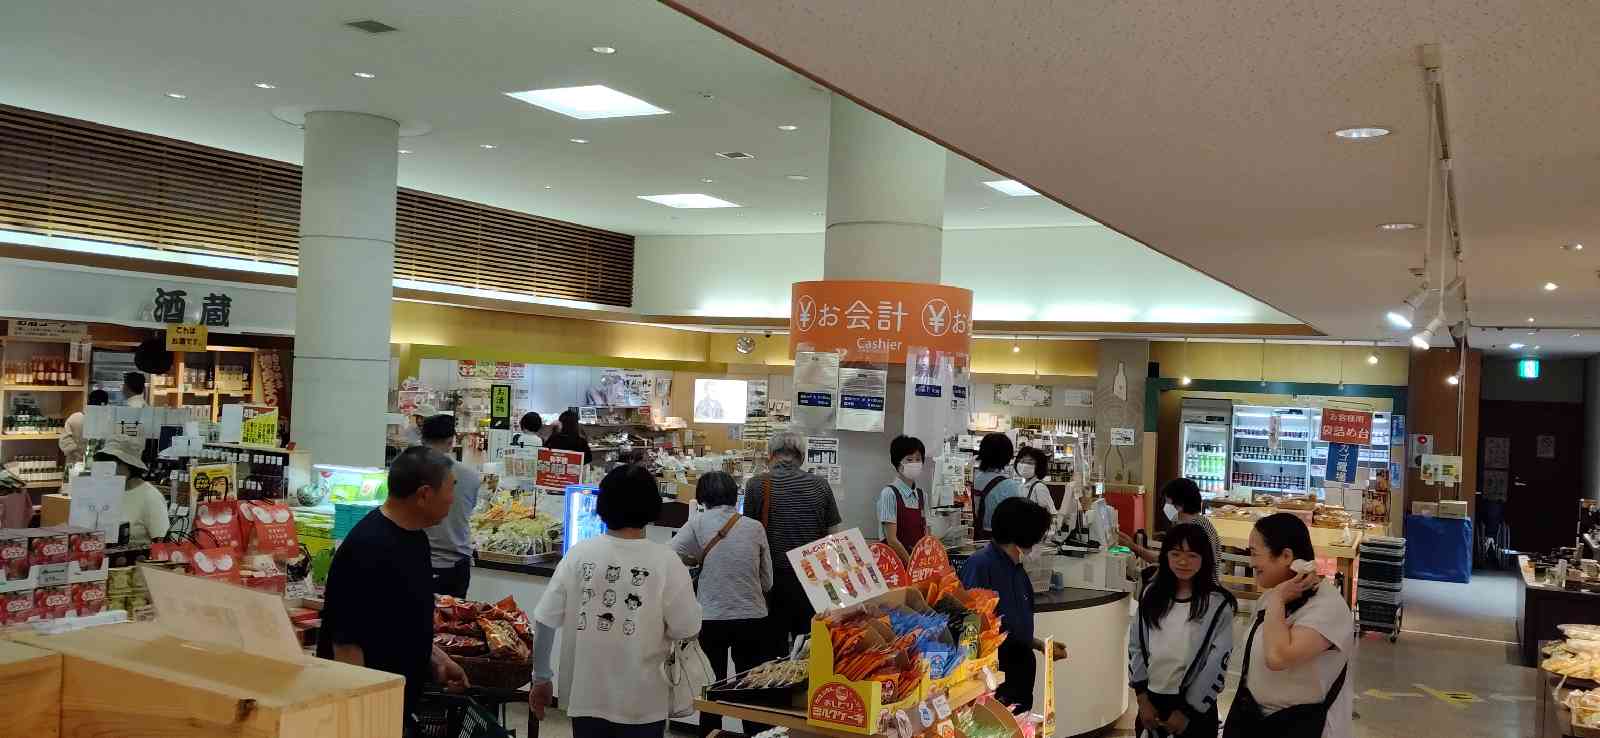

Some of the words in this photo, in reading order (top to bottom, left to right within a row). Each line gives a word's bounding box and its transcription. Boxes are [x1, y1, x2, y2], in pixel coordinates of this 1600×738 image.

[153, 288, 232, 327] 酒蔵
[818, 299, 908, 332] お会計
[952, 310, 973, 335] お
[856, 337, 902, 351] Cashier
